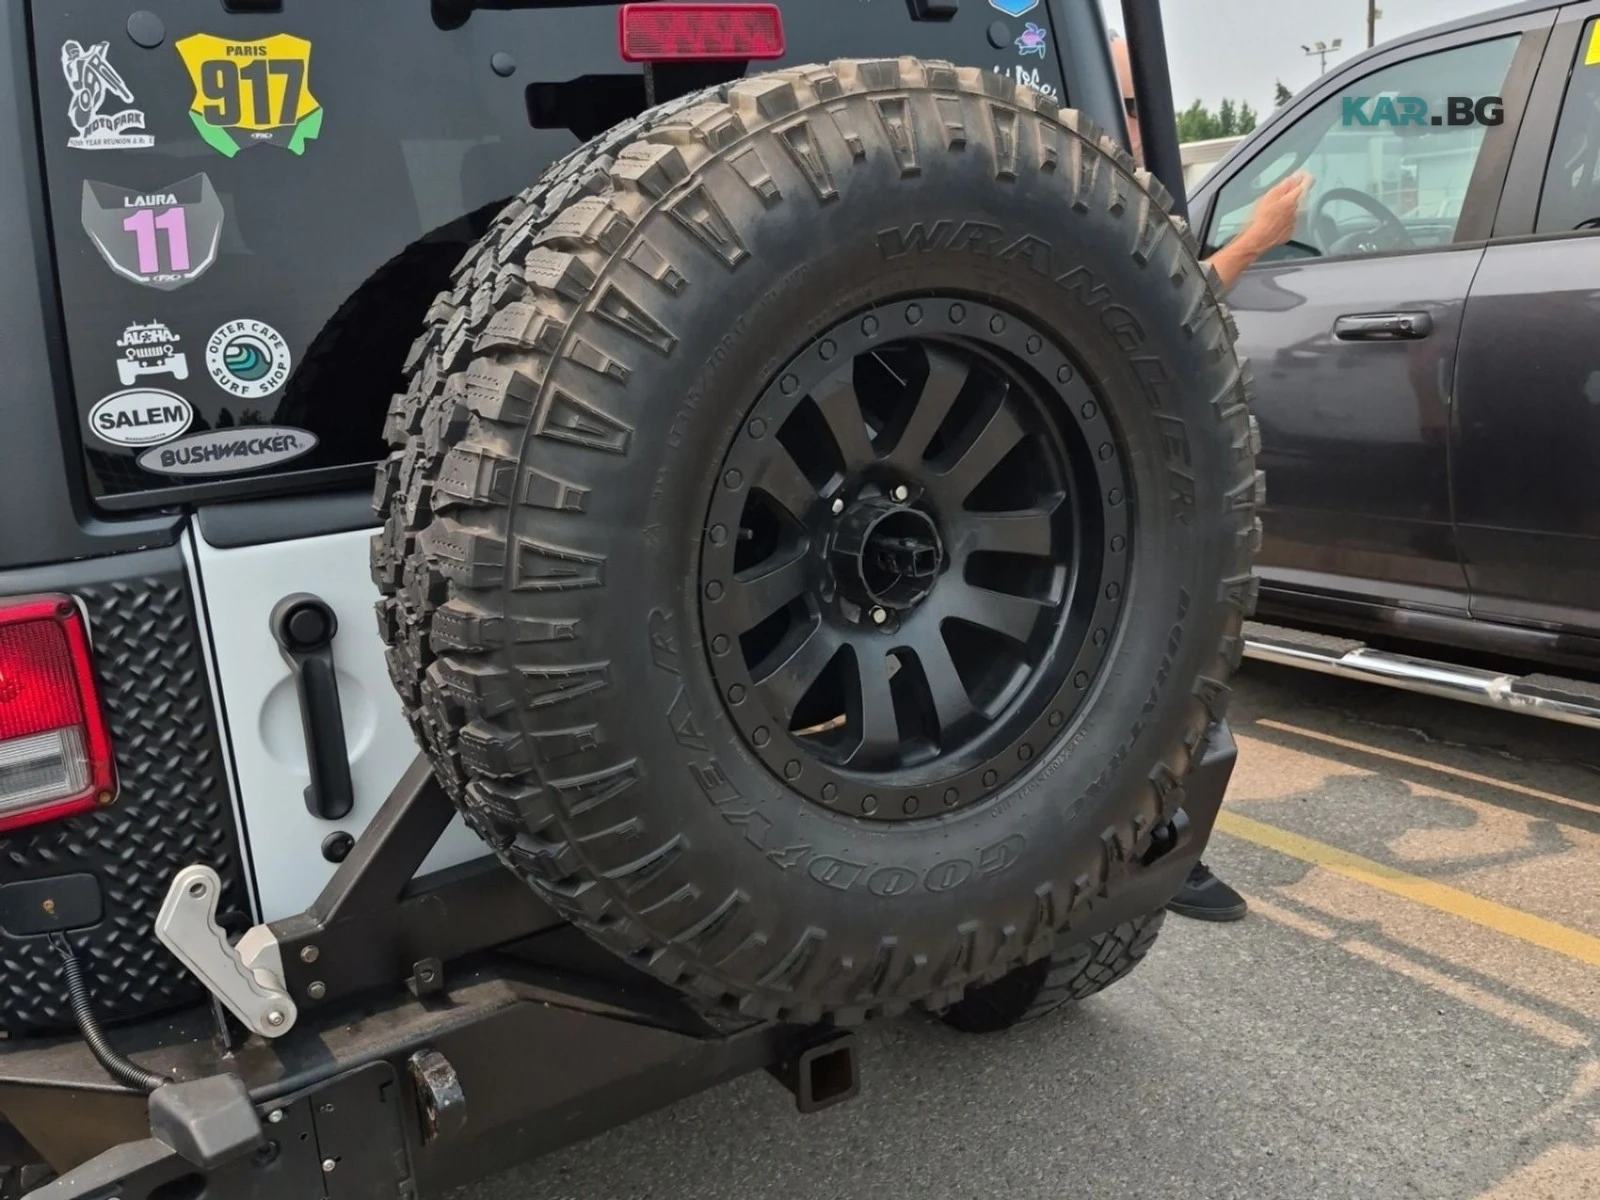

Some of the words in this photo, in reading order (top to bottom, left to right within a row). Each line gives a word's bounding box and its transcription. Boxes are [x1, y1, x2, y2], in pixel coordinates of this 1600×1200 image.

[226, 45, 267, 56] PARIS
[200, 59, 305, 126] 917
[124, 193, 178, 207] LAURA
[123, 206, 190, 273] 11
[209, 322, 245, 354] OUTER
[251, 323, 284, 349] CAPE
[212, 367, 249, 395] SURF
[259, 362, 287, 393] SHOP
[877, 218, 1197, 526] WRANGLER
[99, 405, 185, 430] SALEM
[160, 434, 299, 467] BUSHWACKER
